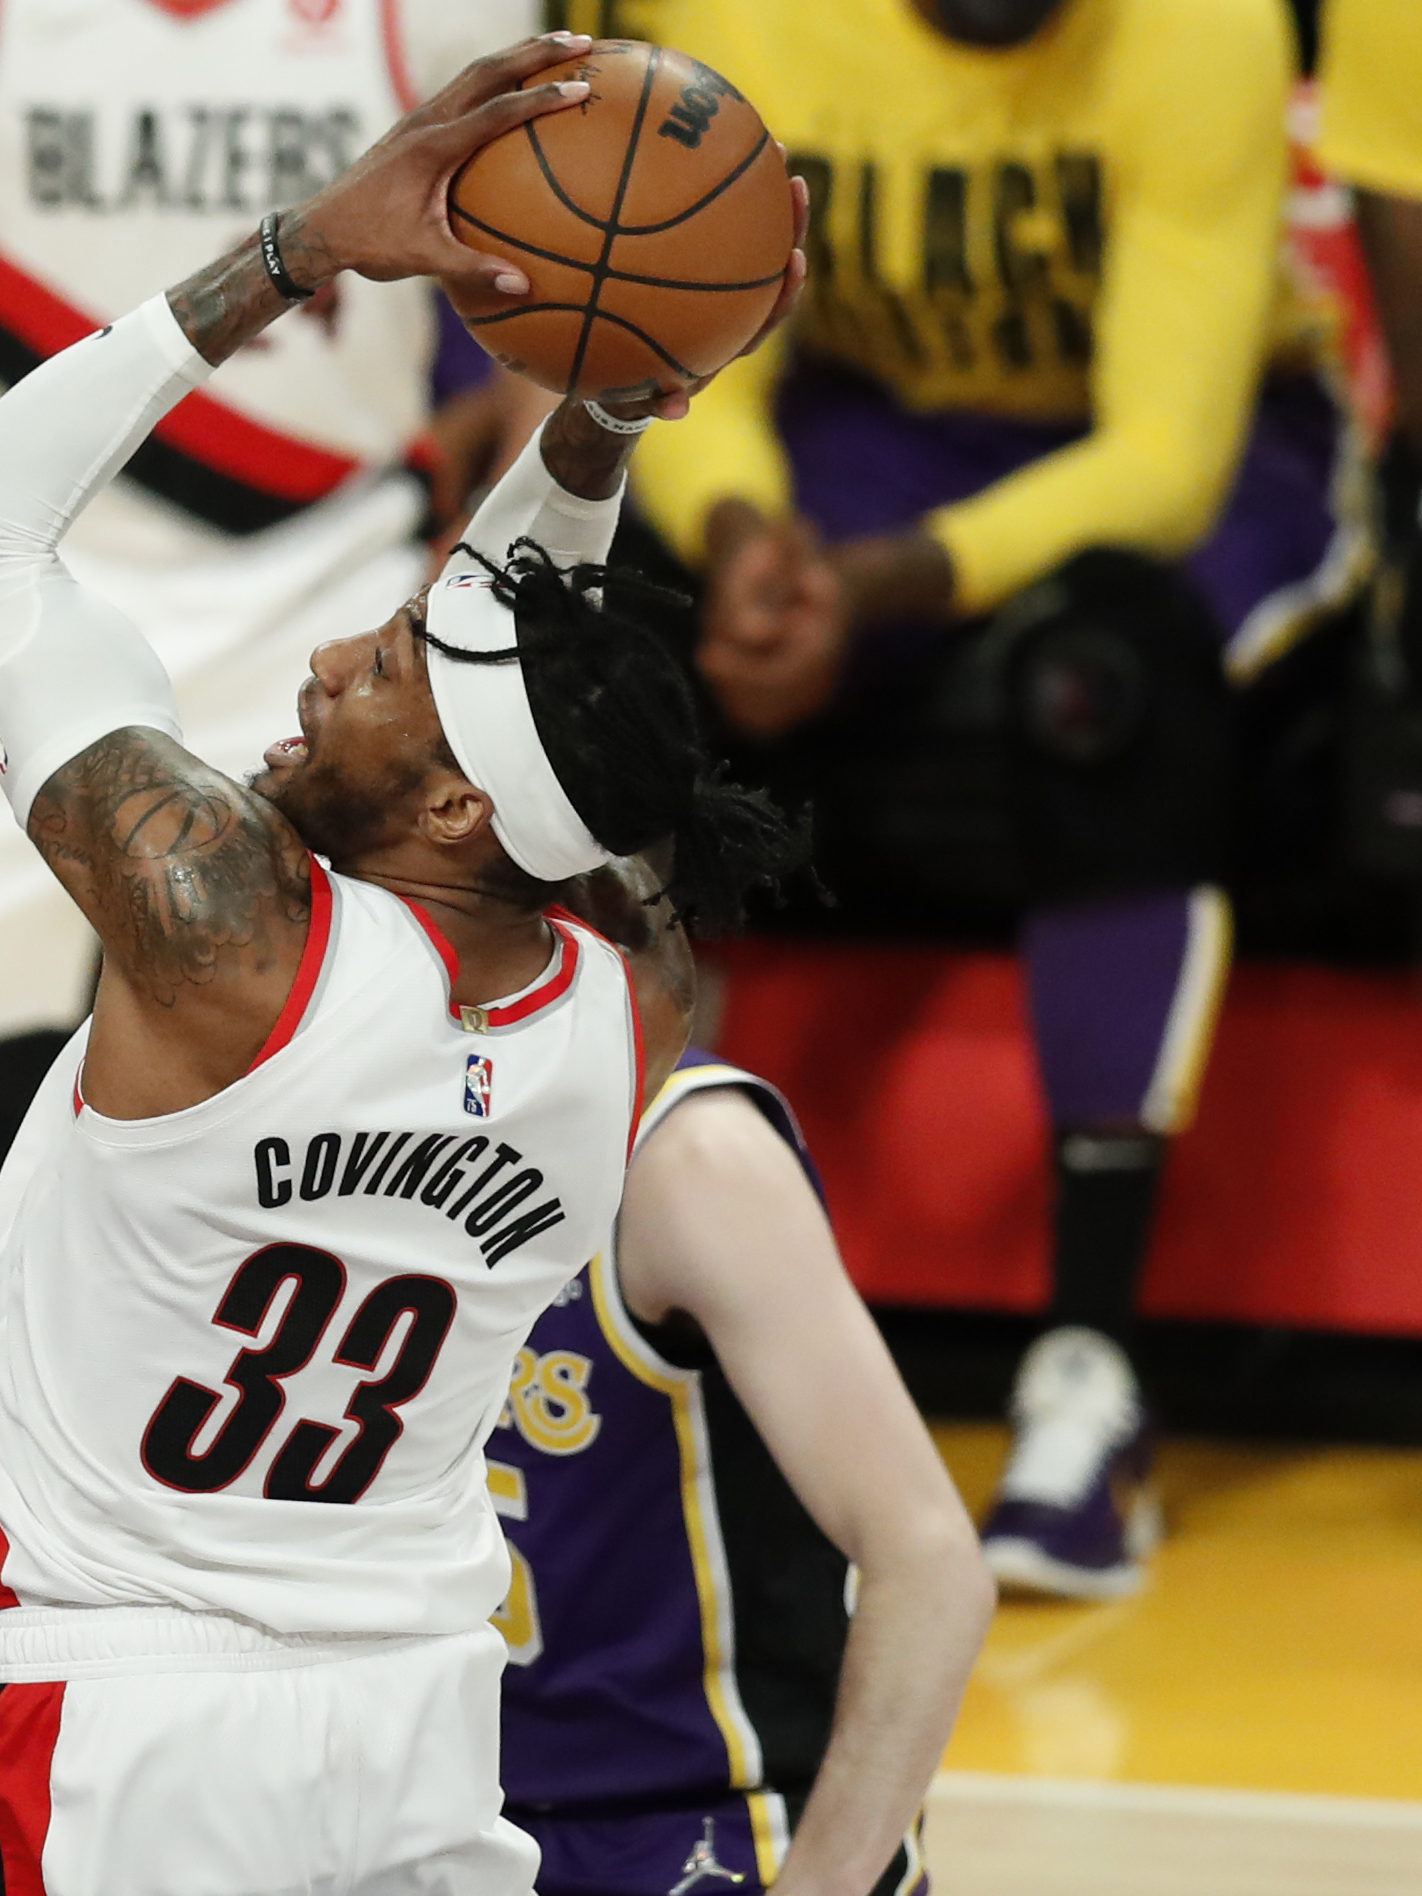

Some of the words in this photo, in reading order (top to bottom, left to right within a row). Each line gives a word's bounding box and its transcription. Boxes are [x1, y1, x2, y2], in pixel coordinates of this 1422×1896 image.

[26, 104, 360, 213] BLAZERS
[265, 244, 281, 275] PLAY
[254, 1131, 566, 1270] COVINGTON
[139, 1241, 458, 1505] 33
